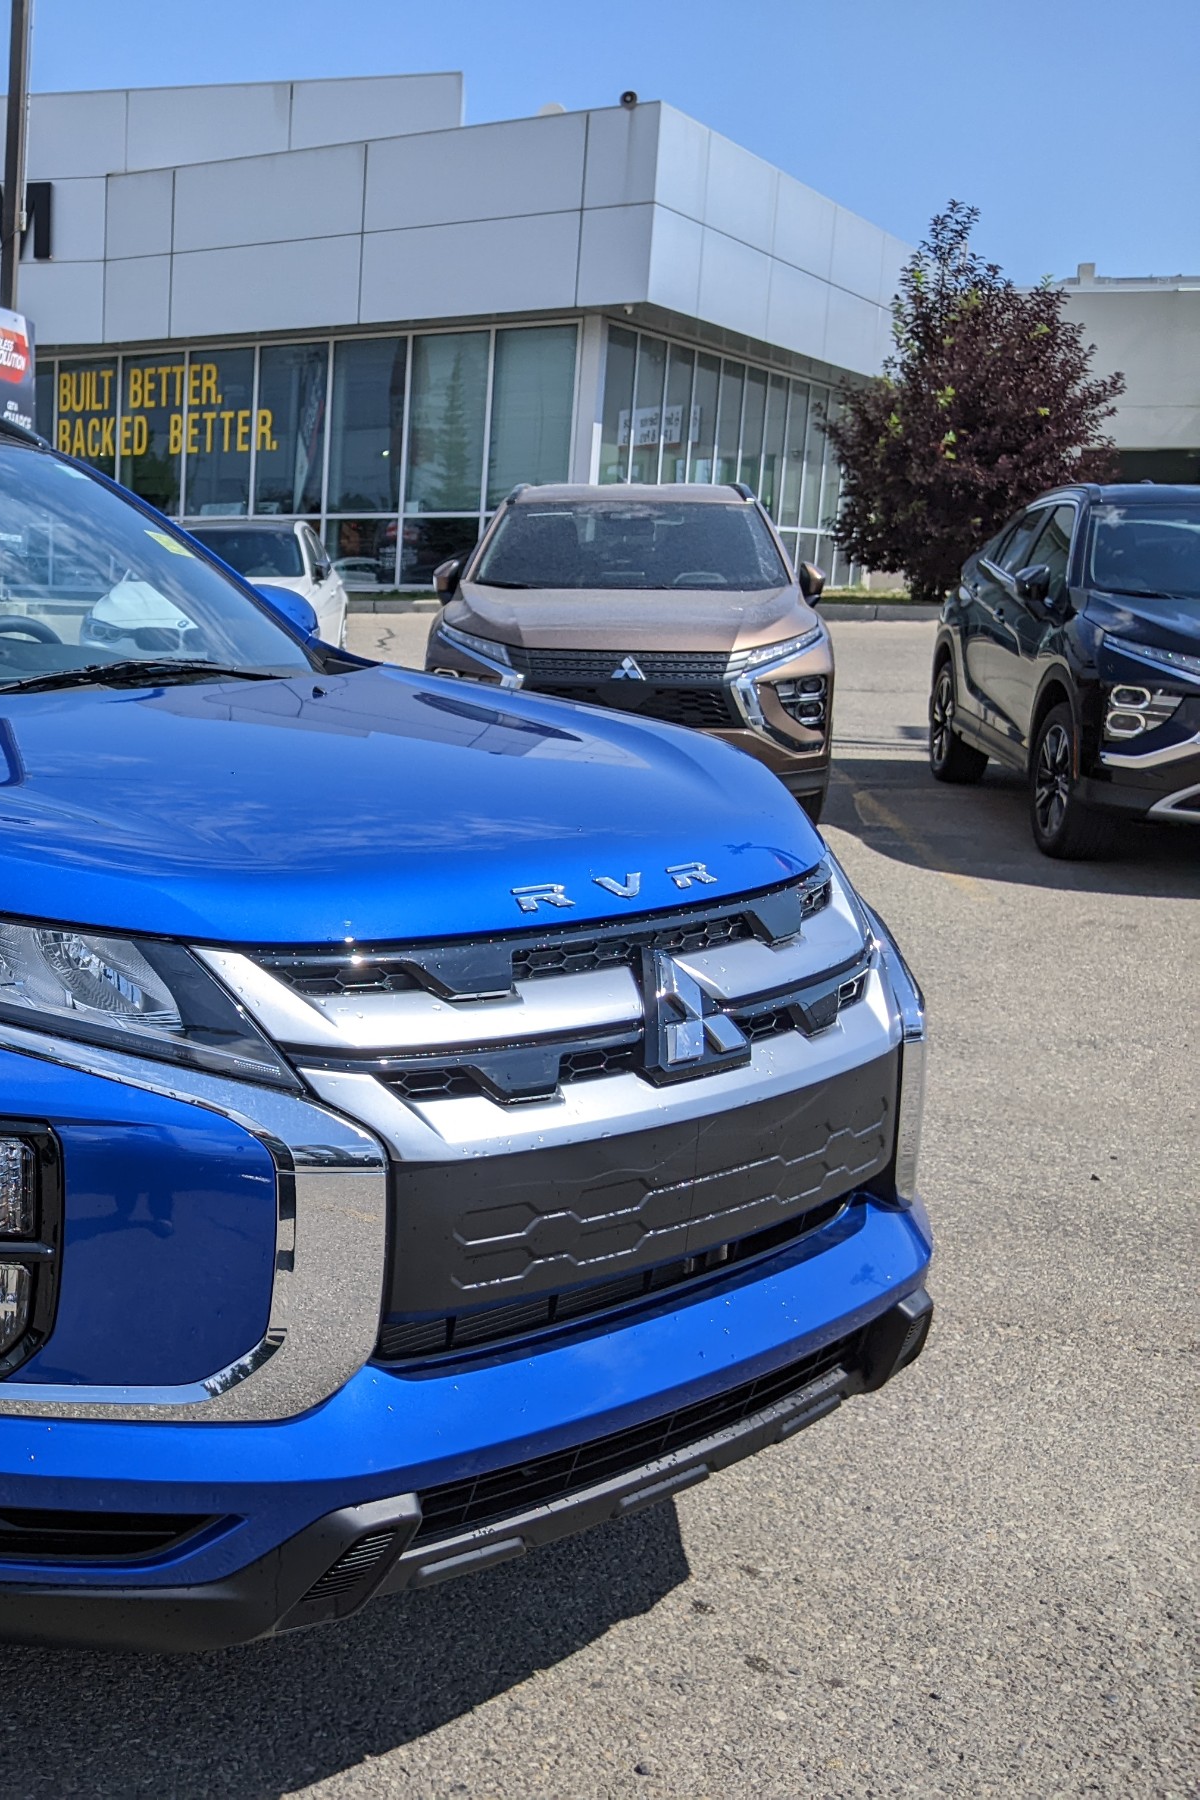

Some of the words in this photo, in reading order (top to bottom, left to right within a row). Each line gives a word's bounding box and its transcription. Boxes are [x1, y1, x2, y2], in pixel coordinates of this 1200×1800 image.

[58, 370, 114, 412] BUILT
[128, 363, 223, 409] BETTER.
[58, 415, 148, 458] BACKED
[168, 408, 278, 455] BETTER.
